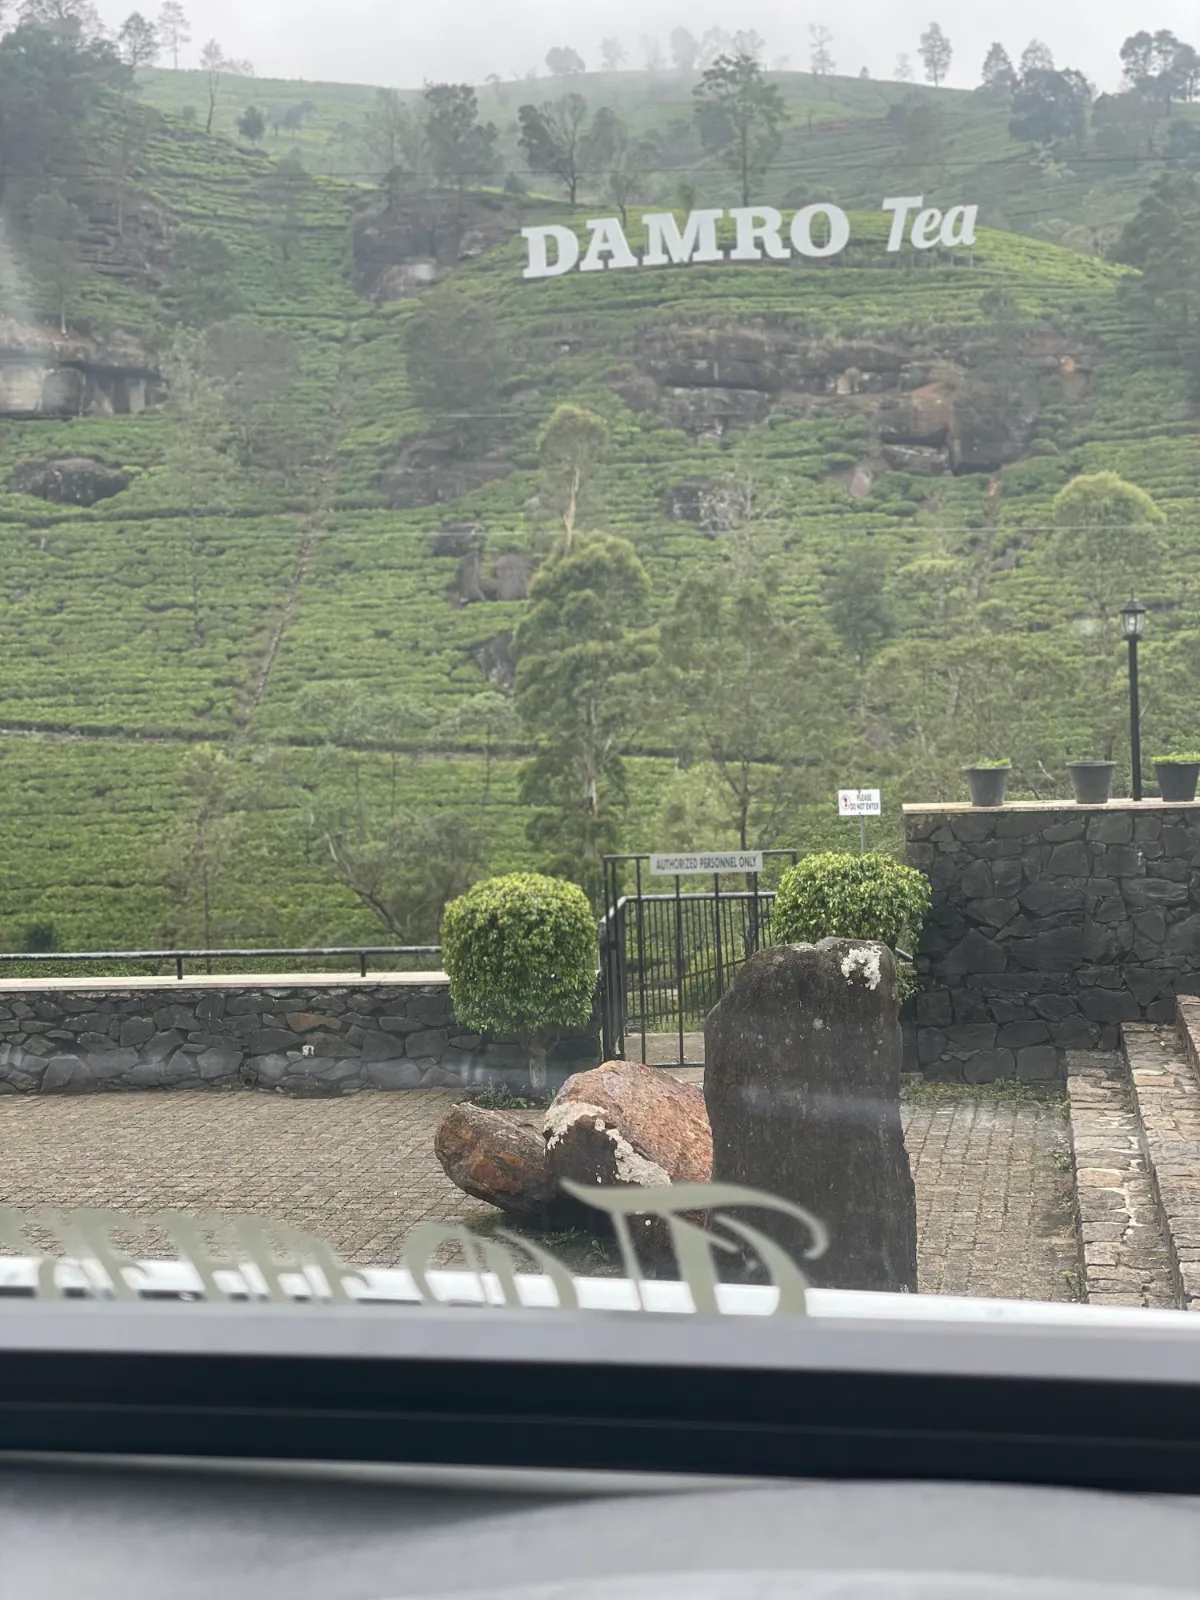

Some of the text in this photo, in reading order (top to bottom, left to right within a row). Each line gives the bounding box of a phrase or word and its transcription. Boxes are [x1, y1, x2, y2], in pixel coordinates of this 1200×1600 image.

[521, 195, 979, 279] DAMRO Tea
[856, 793, 873, 802] PLEASE
[857, 802, 866, 811] NOT
[866, 802, 880, 811] ENTER
[656, 855, 757, 870] AUTHORIZED PERSONNEL ONLY
